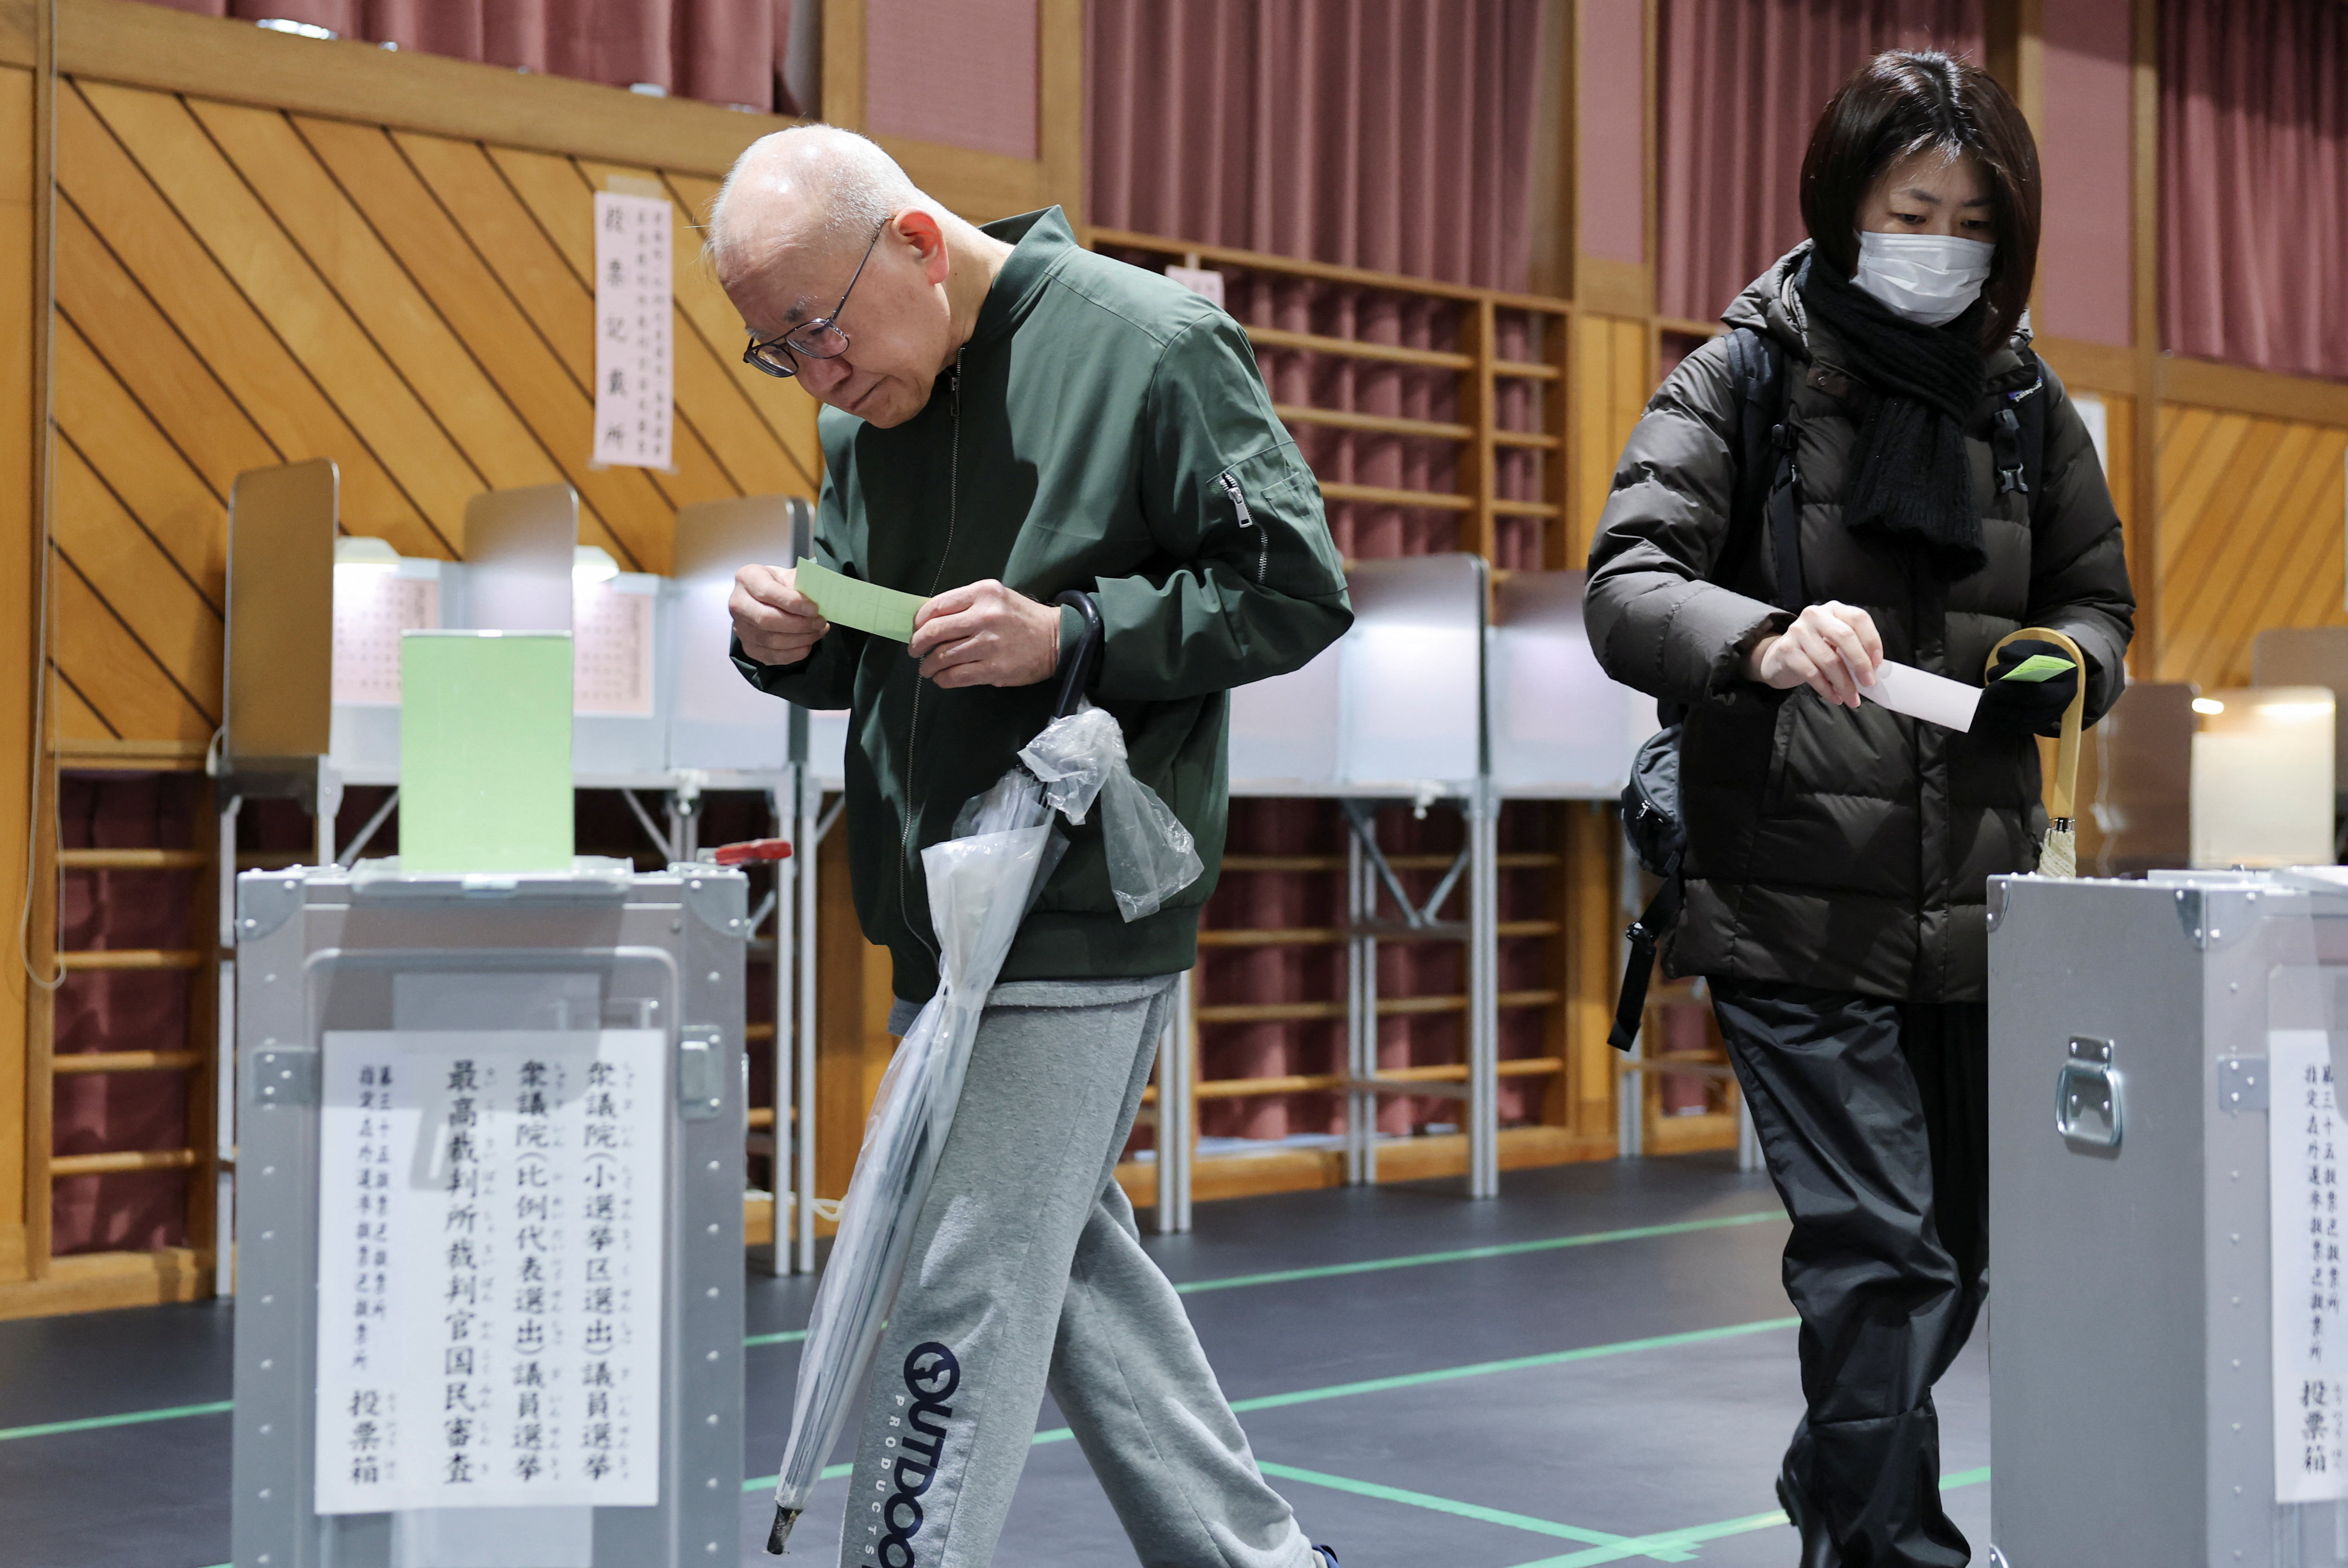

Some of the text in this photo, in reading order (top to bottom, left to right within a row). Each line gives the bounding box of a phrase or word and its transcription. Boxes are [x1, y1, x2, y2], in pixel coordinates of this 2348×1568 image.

[348, 1390, 380, 1484] 投票箱
[862, 1341, 960, 1568] OUTDOO
[865, 1394, 905, 1555] PRODUCTS
[2300, 1380, 2328, 1474] 投票箱
